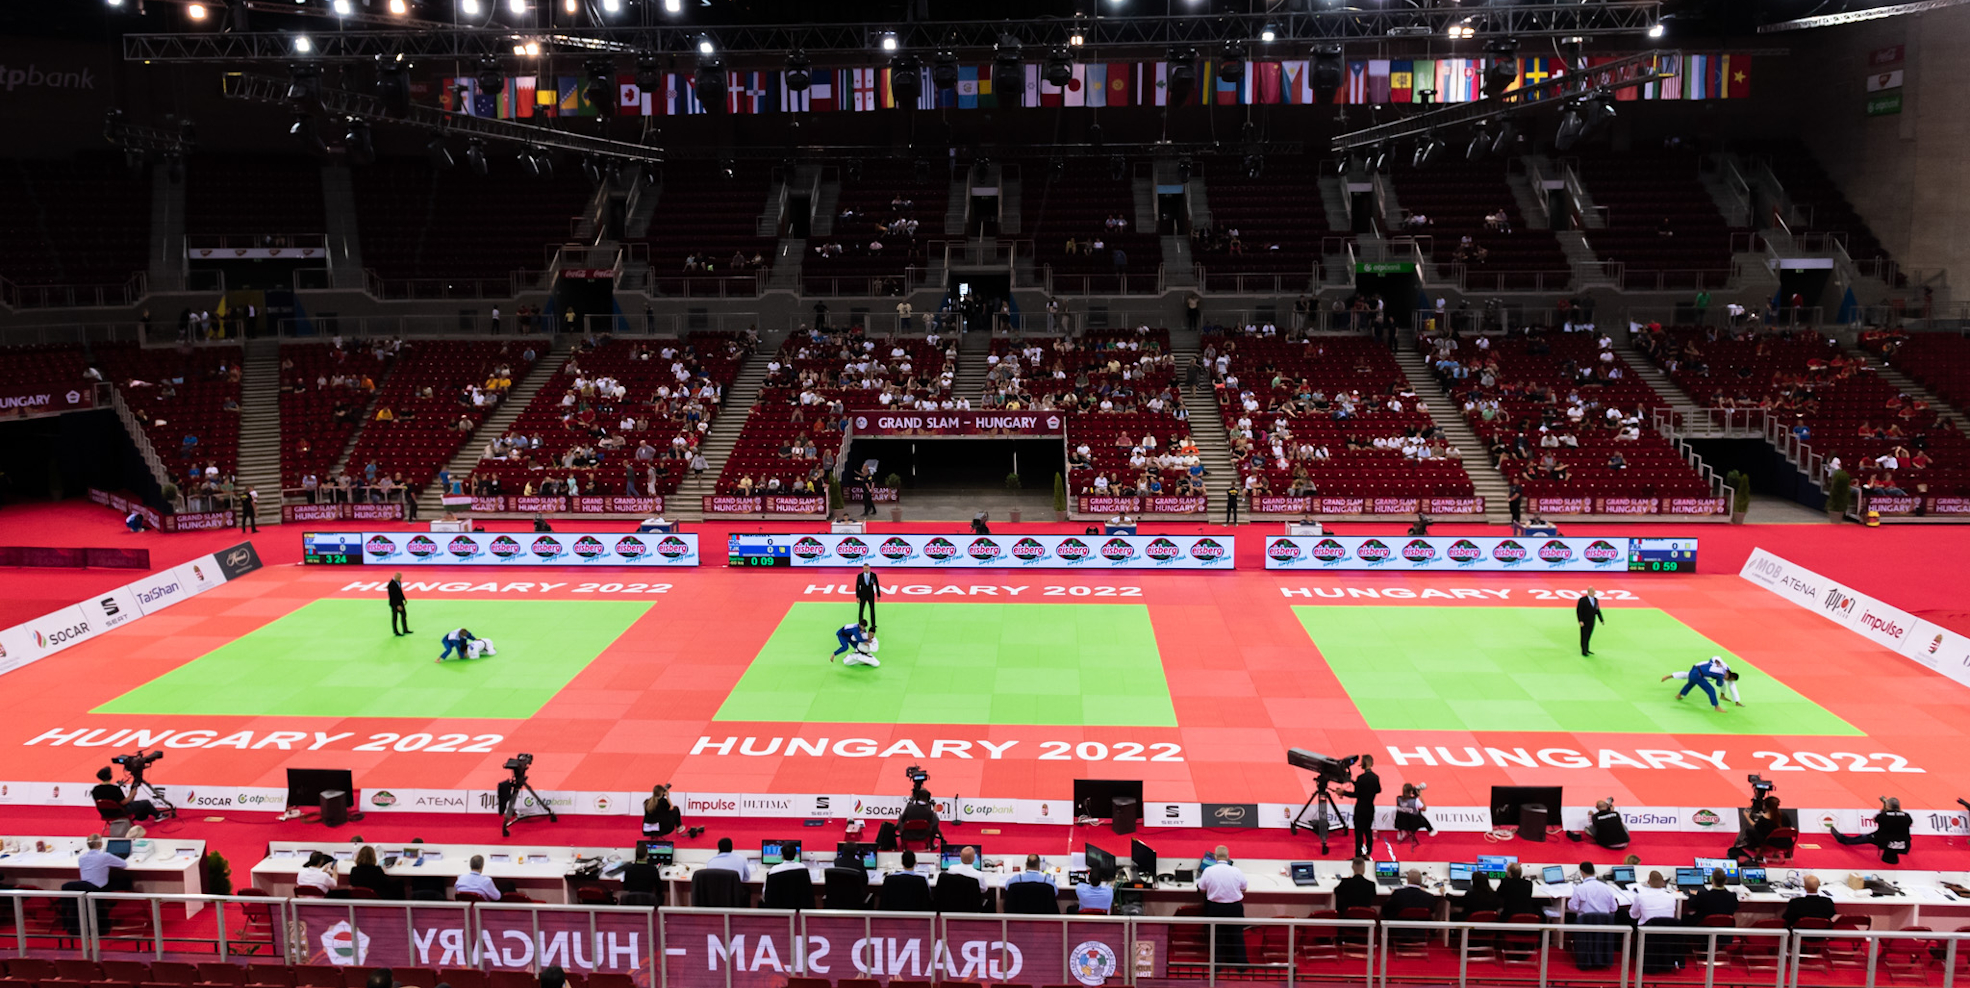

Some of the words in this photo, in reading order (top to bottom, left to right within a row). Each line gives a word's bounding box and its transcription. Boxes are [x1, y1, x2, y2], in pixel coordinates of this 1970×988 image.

[0, 64, 95, 91] tpbank
[0, 394, 50, 408] UNGARY
[878, 417, 922, 429] GRAND
[927, 417, 959, 429] SLAM
[976, 417, 1037, 429] HUNGARY
[366, 542, 395, 554] eisberg
[407, 542, 436, 554] eisberg
[448, 542, 478, 554] eisberg
[490, 542, 519, 554] eisberg
[532, 543, 561, 554] eisberg
[574, 543, 603, 554] eisberg
[616, 543, 645, 554] eisberg
[658, 543, 687, 555] eisberg
[794, 543, 824, 555] eisberg
[837, 543, 868, 555] eisberg
[881, 543, 911, 555] eisberg
[924, 543, 955, 555] eisberg
[969, 544, 1000, 556] eisberg
[1013, 544, 1044, 556] eisberg
[1057, 544, 1088, 556] eisberg
[1102, 544, 1132, 556] eisberg
[1147, 544, 1178, 556] eisberg
[1192, 544, 1223, 556] eisberg
[1269, 544, 1299, 556] eisberg
[1314, 545, 1344, 556] eisberg
[1359, 545, 1388, 557] eisberg
[1404, 545, 1434, 557] eisberg
[1449, 545, 1479, 557] eisberg
[1494, 546, 1525, 557] eisberg
[1540, 546, 1570, 557] eisberg
[1585, 546, 1616, 558] eisberg
[326, 555, 332, 563] 3
[334, 555, 347, 563] 24
[751, 557, 758, 565] 0
[760, 557, 774, 565] 09
[1652, 562, 1660, 571] 0
[1663, 562, 1678, 571] 59
[1756, 558, 1782, 578] MOB
[571, 583, 674, 593] 2022
[1043, 586, 1143, 595] 2022
[1780, 575, 1816, 598] ATENA
[137, 582, 179, 604] TaiShan
[1280, 587, 1510, 599] HUNGARY
[1861, 609, 1903, 638] impulse
[50, 622, 90, 646] SOCAR
[23, 728, 354, 750] HUNGARY
[352, 733, 504, 752] 2022
[689, 736, 1019, 759] HUNGARY
[1037, 740, 1184, 761] 2022
[1386, 746, 1732, 771] HUNGARY
[1752, 751, 1927, 774] 2022
[197, 797, 232, 806] SOCAR
[249, 795, 284, 805] otpbank
[416, 797, 464, 806] ATENA
[688, 798, 735, 812] impulse
[744, 800, 788, 808] ULTIMA
[866, 806, 902, 815] SOCAR
[976, 805, 1013, 816] otpbank
[1436, 813, 1483, 822] ULTIMA
[1623, 814, 1676, 824] TaiShan
[1694, 814, 1719, 824] eisberg
